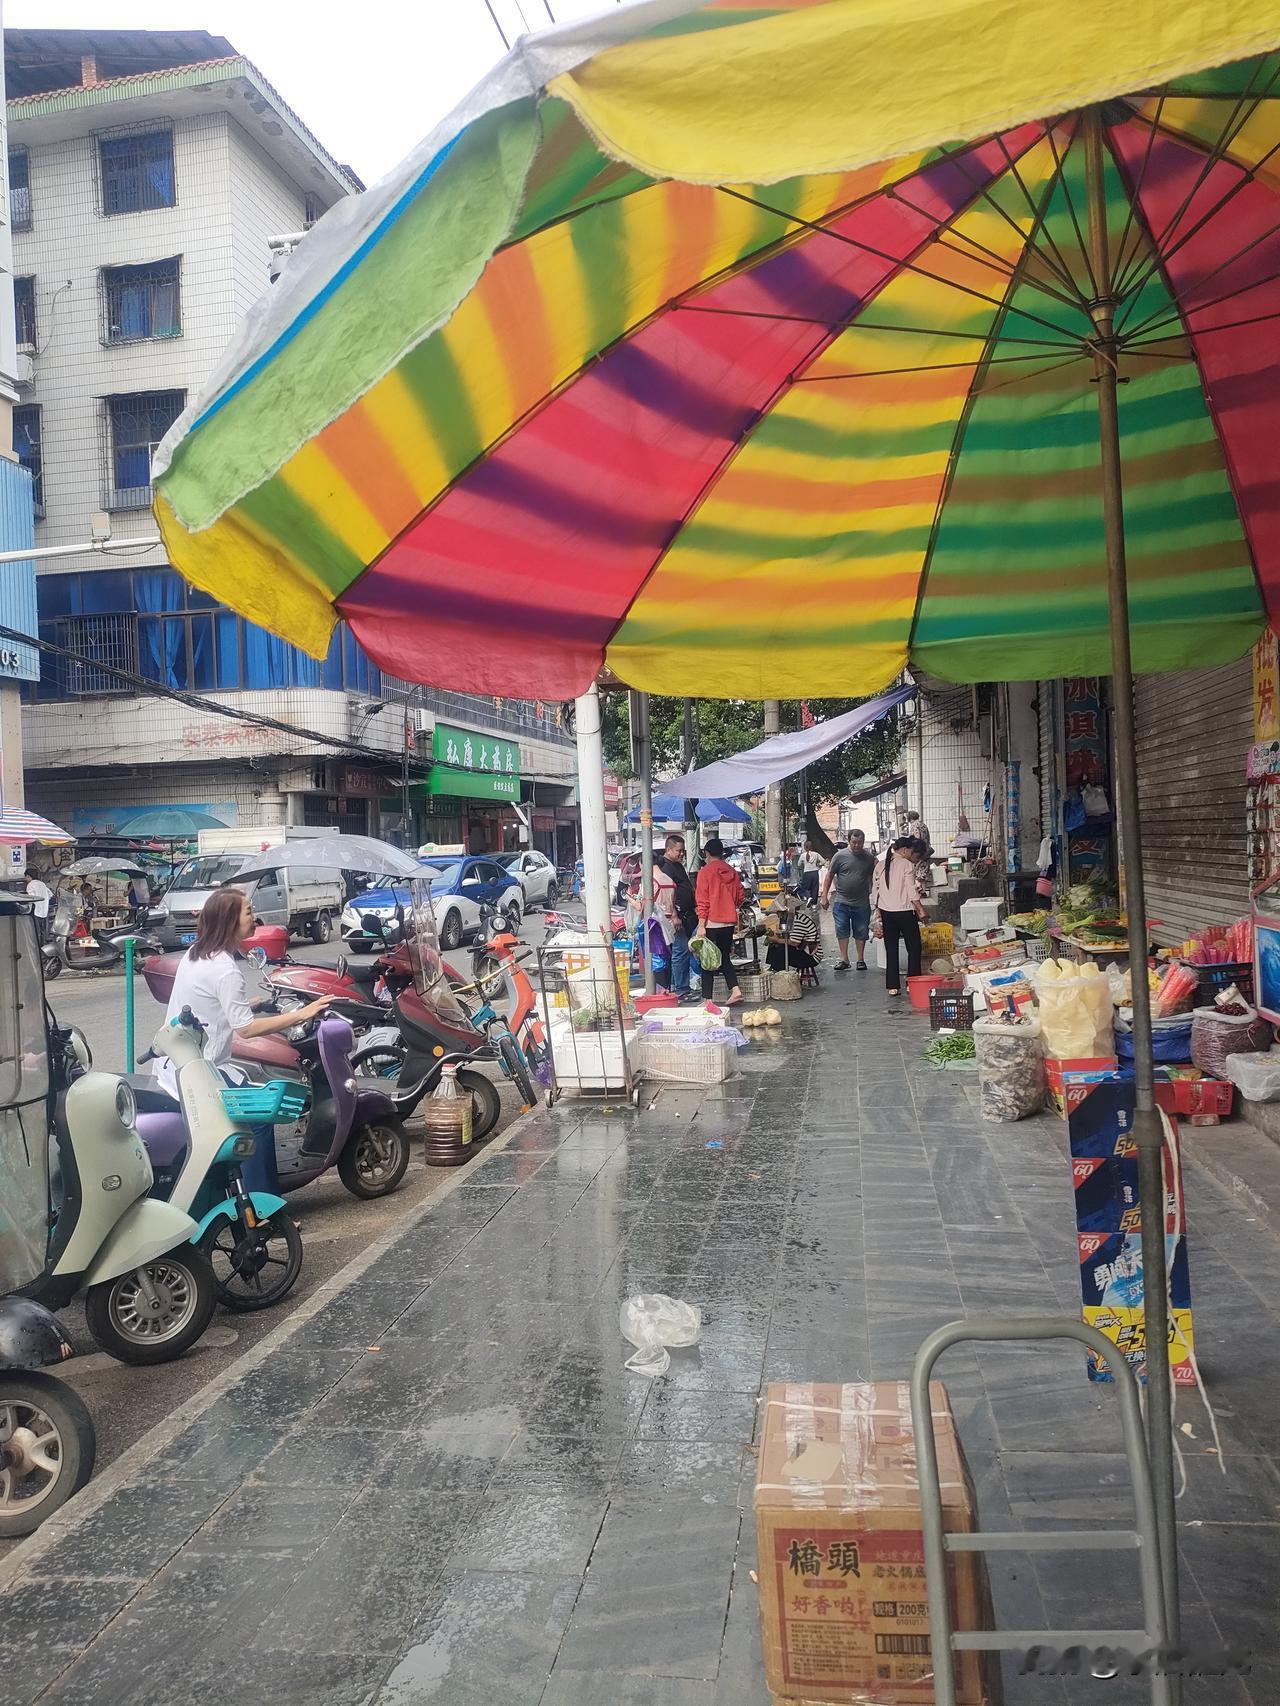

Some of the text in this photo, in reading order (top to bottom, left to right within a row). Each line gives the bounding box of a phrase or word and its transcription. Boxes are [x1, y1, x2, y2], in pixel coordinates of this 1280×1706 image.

[1068, 1088, 1087, 1101] 60
[1074, 1164, 1094, 1176] 60
[1080, 1238, 1100, 1250] 60
[1176, 1367, 1192, 1379] 70
[788, 1539, 861, 1579] 橋頭
[873, 1602, 896, 1617] 规格
